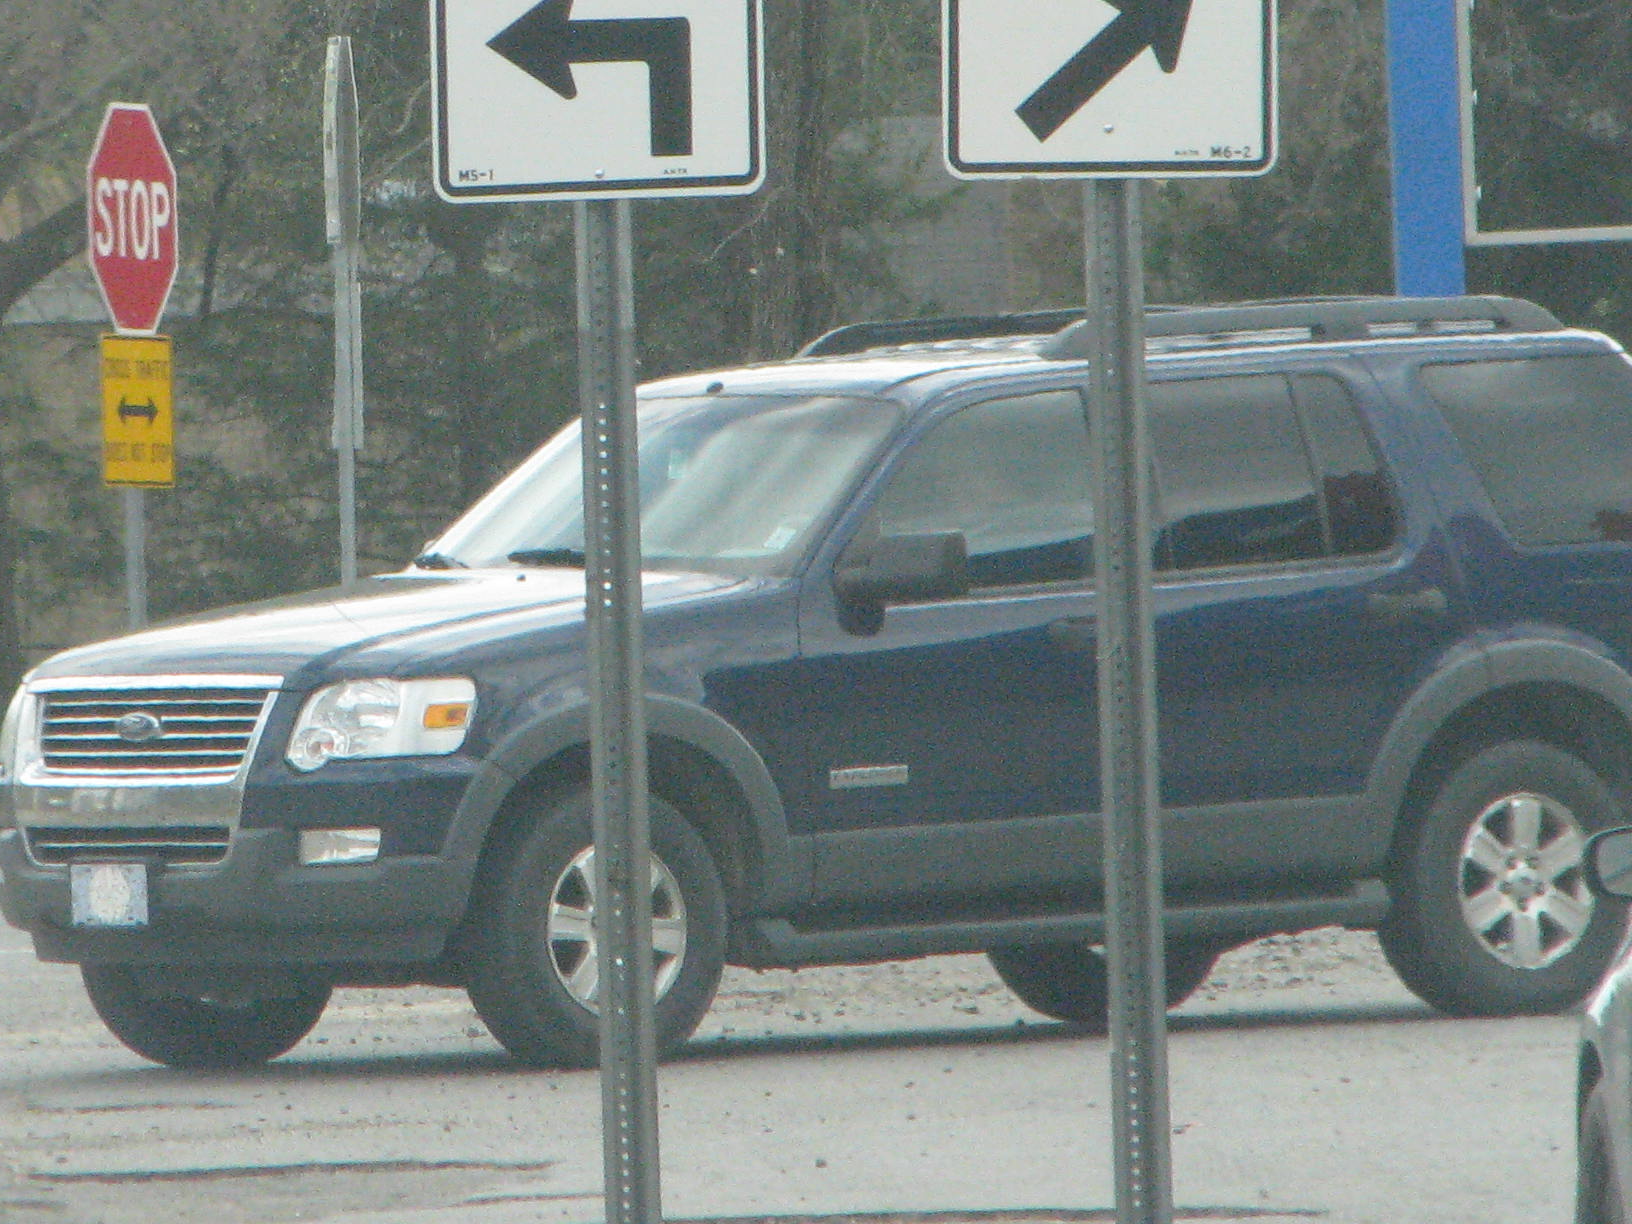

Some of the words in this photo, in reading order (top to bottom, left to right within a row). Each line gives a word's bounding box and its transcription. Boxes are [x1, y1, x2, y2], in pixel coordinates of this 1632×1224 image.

[1209, 145, 1252, 158] M6-2
[458, 169, 495, 182] M5-1
[94, 177, 171, 260] STOP
